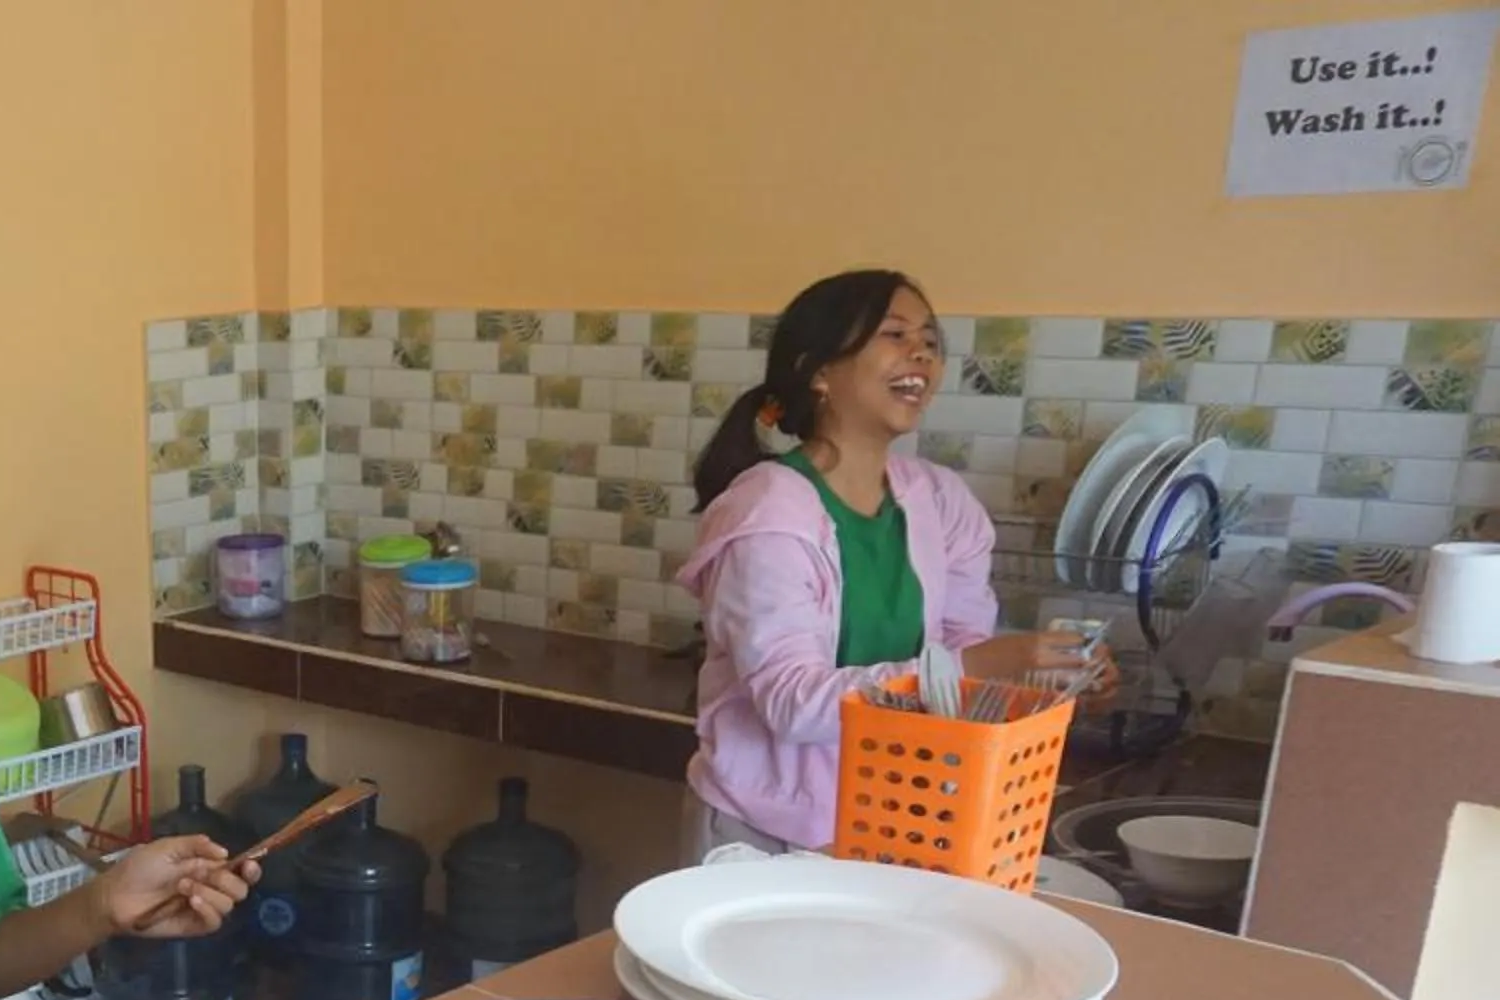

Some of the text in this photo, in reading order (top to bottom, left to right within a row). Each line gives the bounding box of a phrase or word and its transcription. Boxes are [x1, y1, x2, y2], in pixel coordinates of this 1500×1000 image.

[1290, 46, 1437, 84] Use it..!
[1265, 99, 1445, 136] Wash it..!
